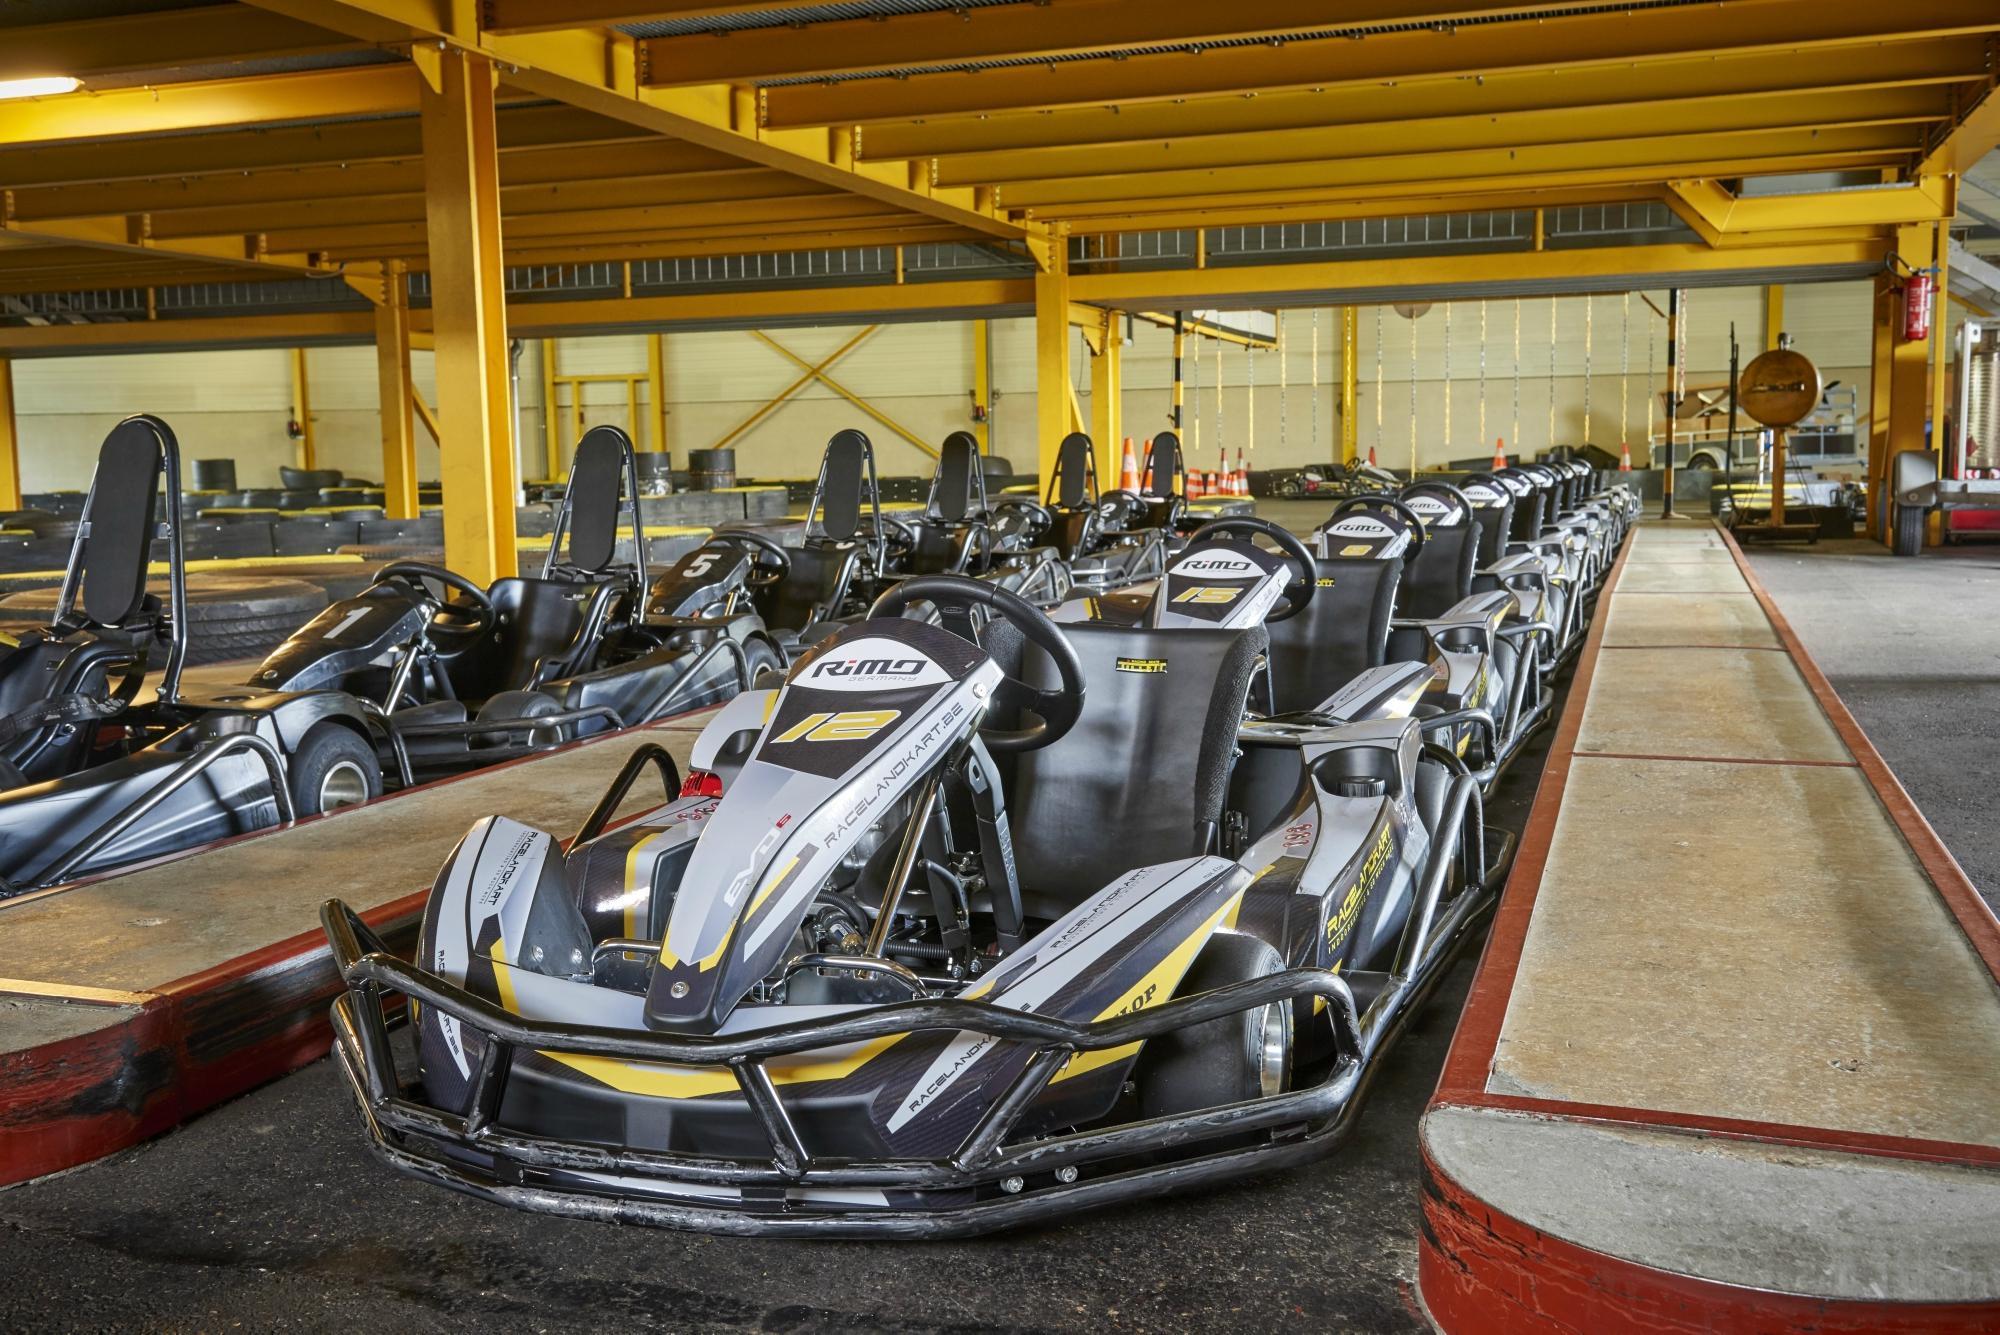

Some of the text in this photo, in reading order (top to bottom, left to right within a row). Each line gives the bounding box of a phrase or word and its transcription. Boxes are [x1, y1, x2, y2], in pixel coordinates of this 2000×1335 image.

[1099, 502, 1117, 517] 2
[682, 554, 722, 578] 5
[1182, 560, 1252, 571] RiMO
[1170, 586, 1245, 604] 15
[322, 606, 374, 640] 1
[811, 659, 928, 678] RiMO
[769, 709, 902, 744] 12
[823, 701, 963, 849] RACELANDKART.BE
[488, 831, 539, 906] RACELANDKART
[1327, 822, 1391, 938] RACELANDKART
